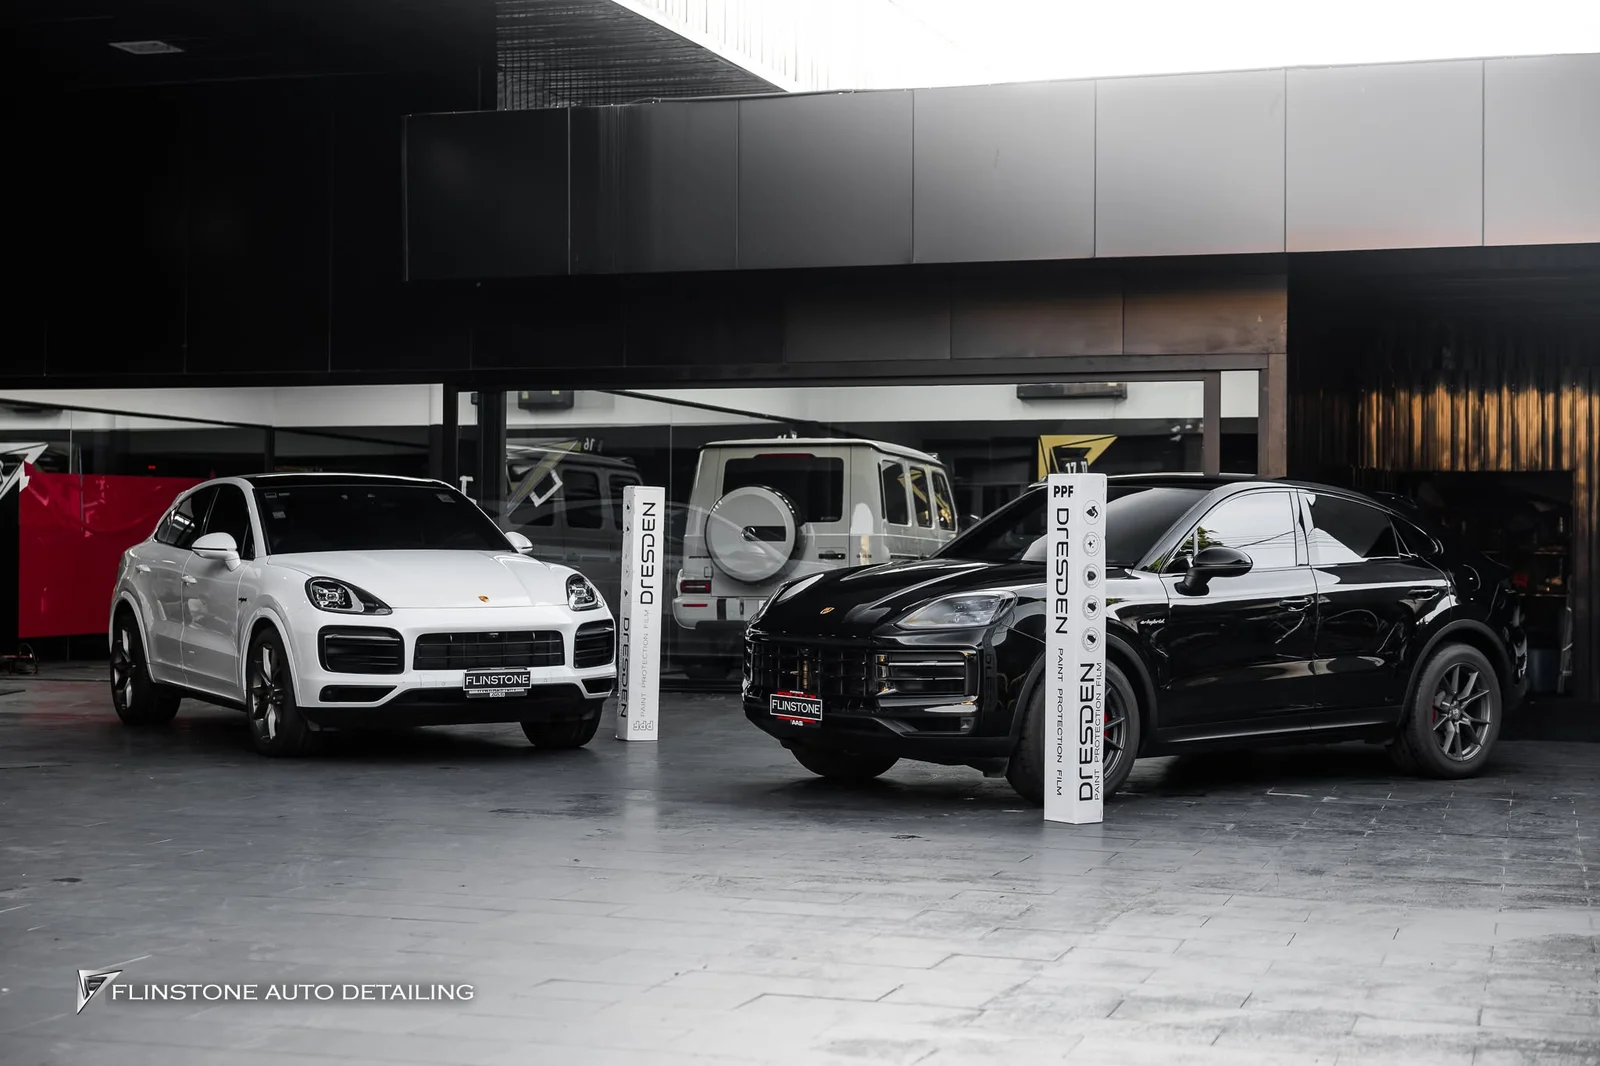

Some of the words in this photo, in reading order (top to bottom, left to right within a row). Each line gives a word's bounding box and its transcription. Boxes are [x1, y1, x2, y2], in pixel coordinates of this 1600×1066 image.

[1053, 485, 1074, 498] PPF
[641, 632, 649, 688] PROTECTION
[466, 674, 530, 685] FLINSTONE
[772, 699, 821, 715] FLINSTONE
[633, 720, 654, 731] PPF
[1094, 693, 1102, 762] PROTECTION
